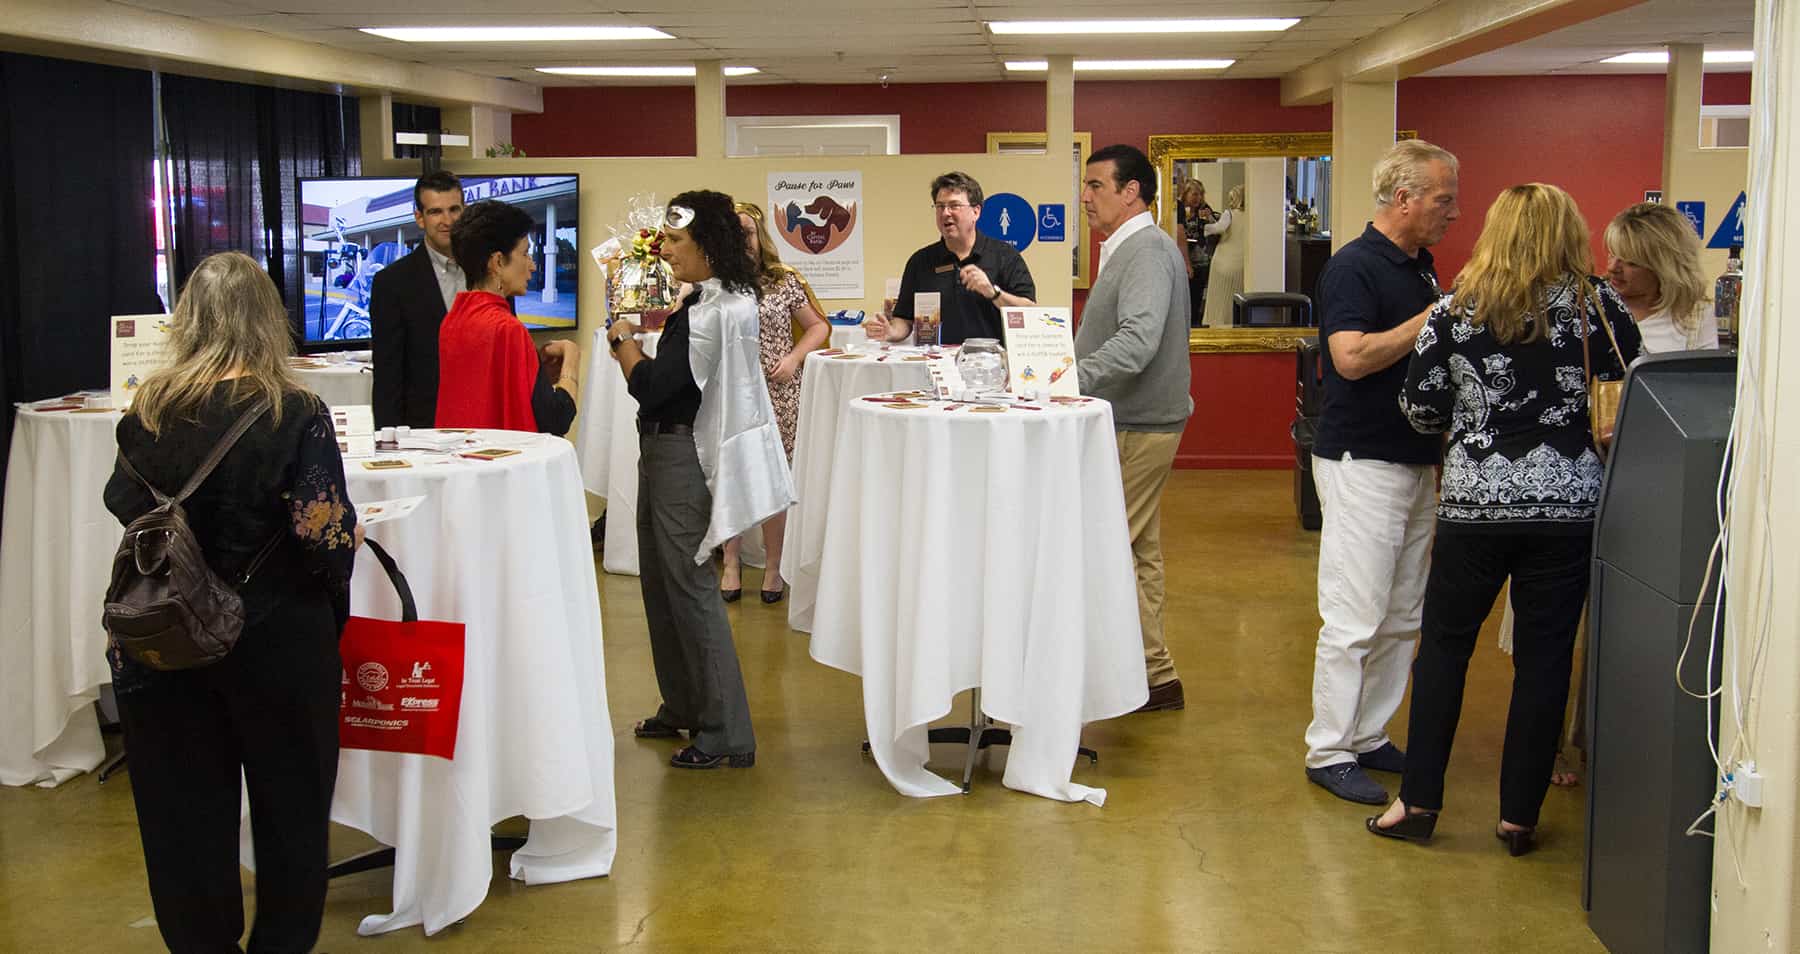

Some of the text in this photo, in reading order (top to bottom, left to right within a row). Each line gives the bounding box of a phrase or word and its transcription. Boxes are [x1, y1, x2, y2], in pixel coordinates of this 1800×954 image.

[490, 177, 538, 197] BANK
[775, 179, 855, 192] Pause for Paws
